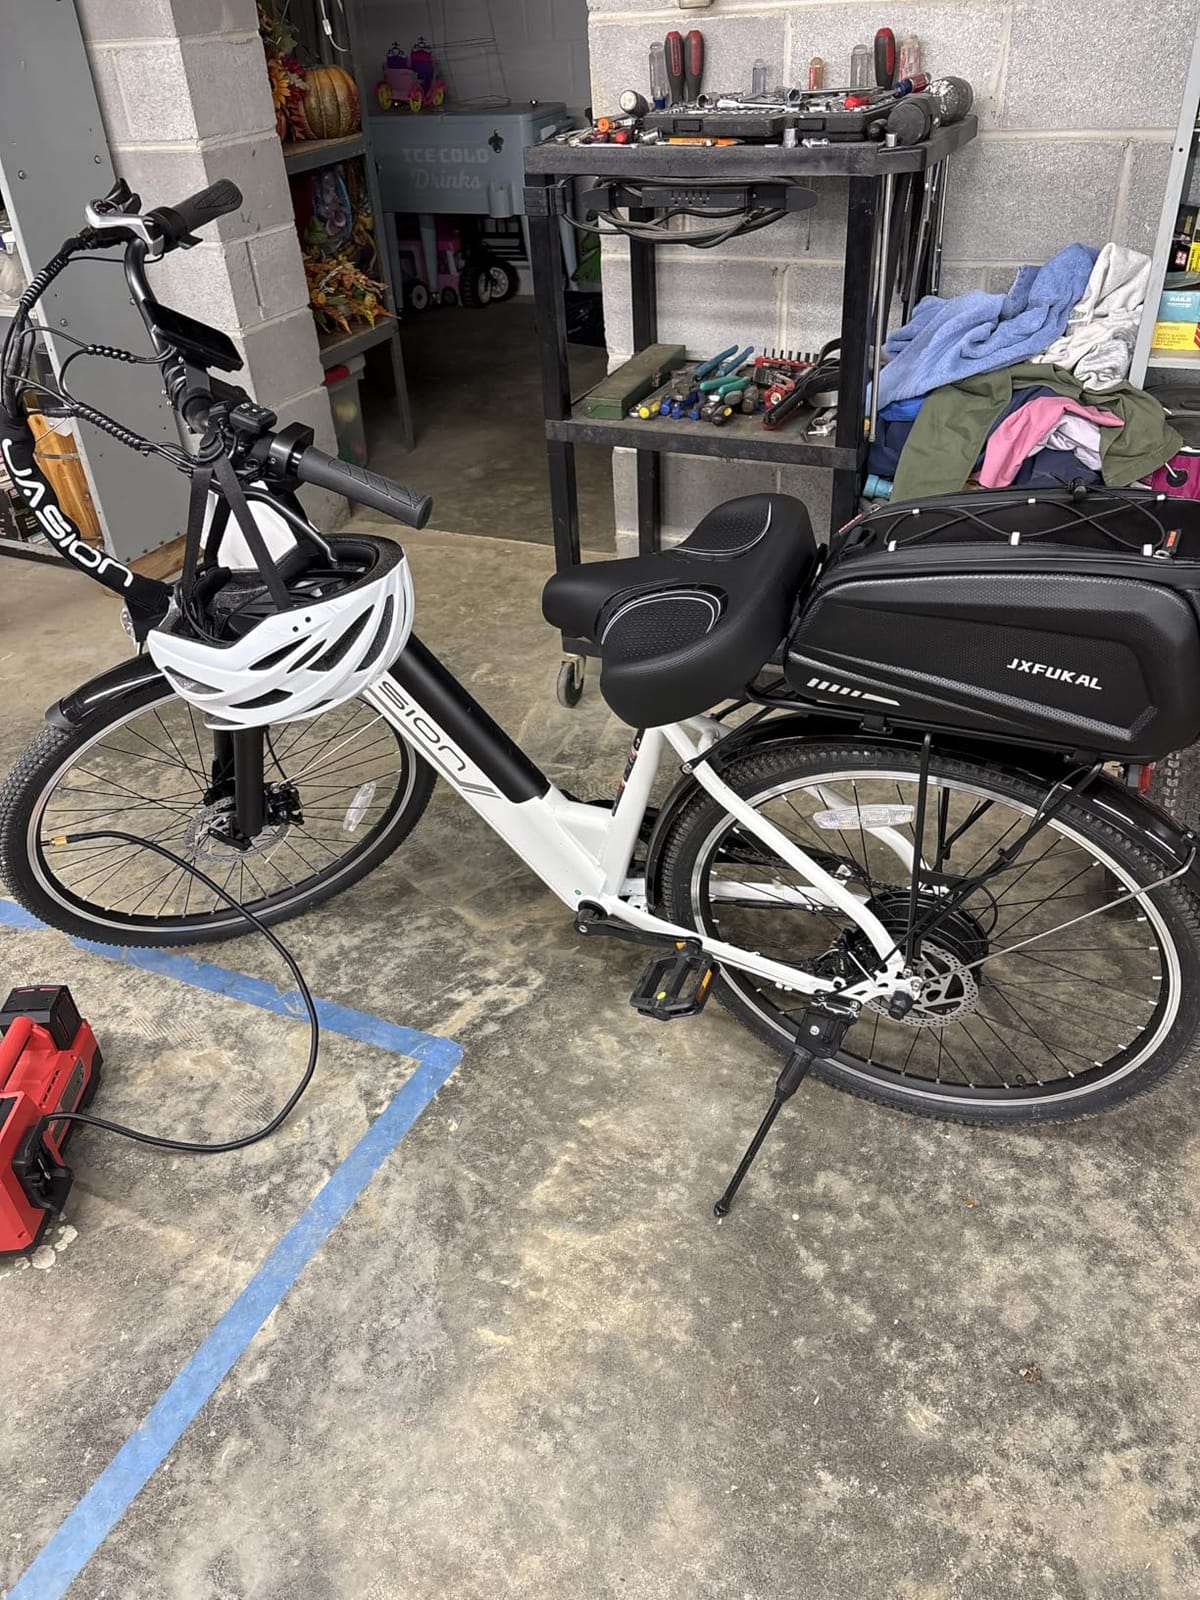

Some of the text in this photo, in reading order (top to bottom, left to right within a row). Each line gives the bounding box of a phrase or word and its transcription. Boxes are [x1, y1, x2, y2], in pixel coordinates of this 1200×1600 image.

[402, 148, 489, 163] ICE COLD
[411, 168, 481, 190] Drinks
[1006, 658, 1103, 690] JXFUKAL
[378, 680, 467, 772] SION
